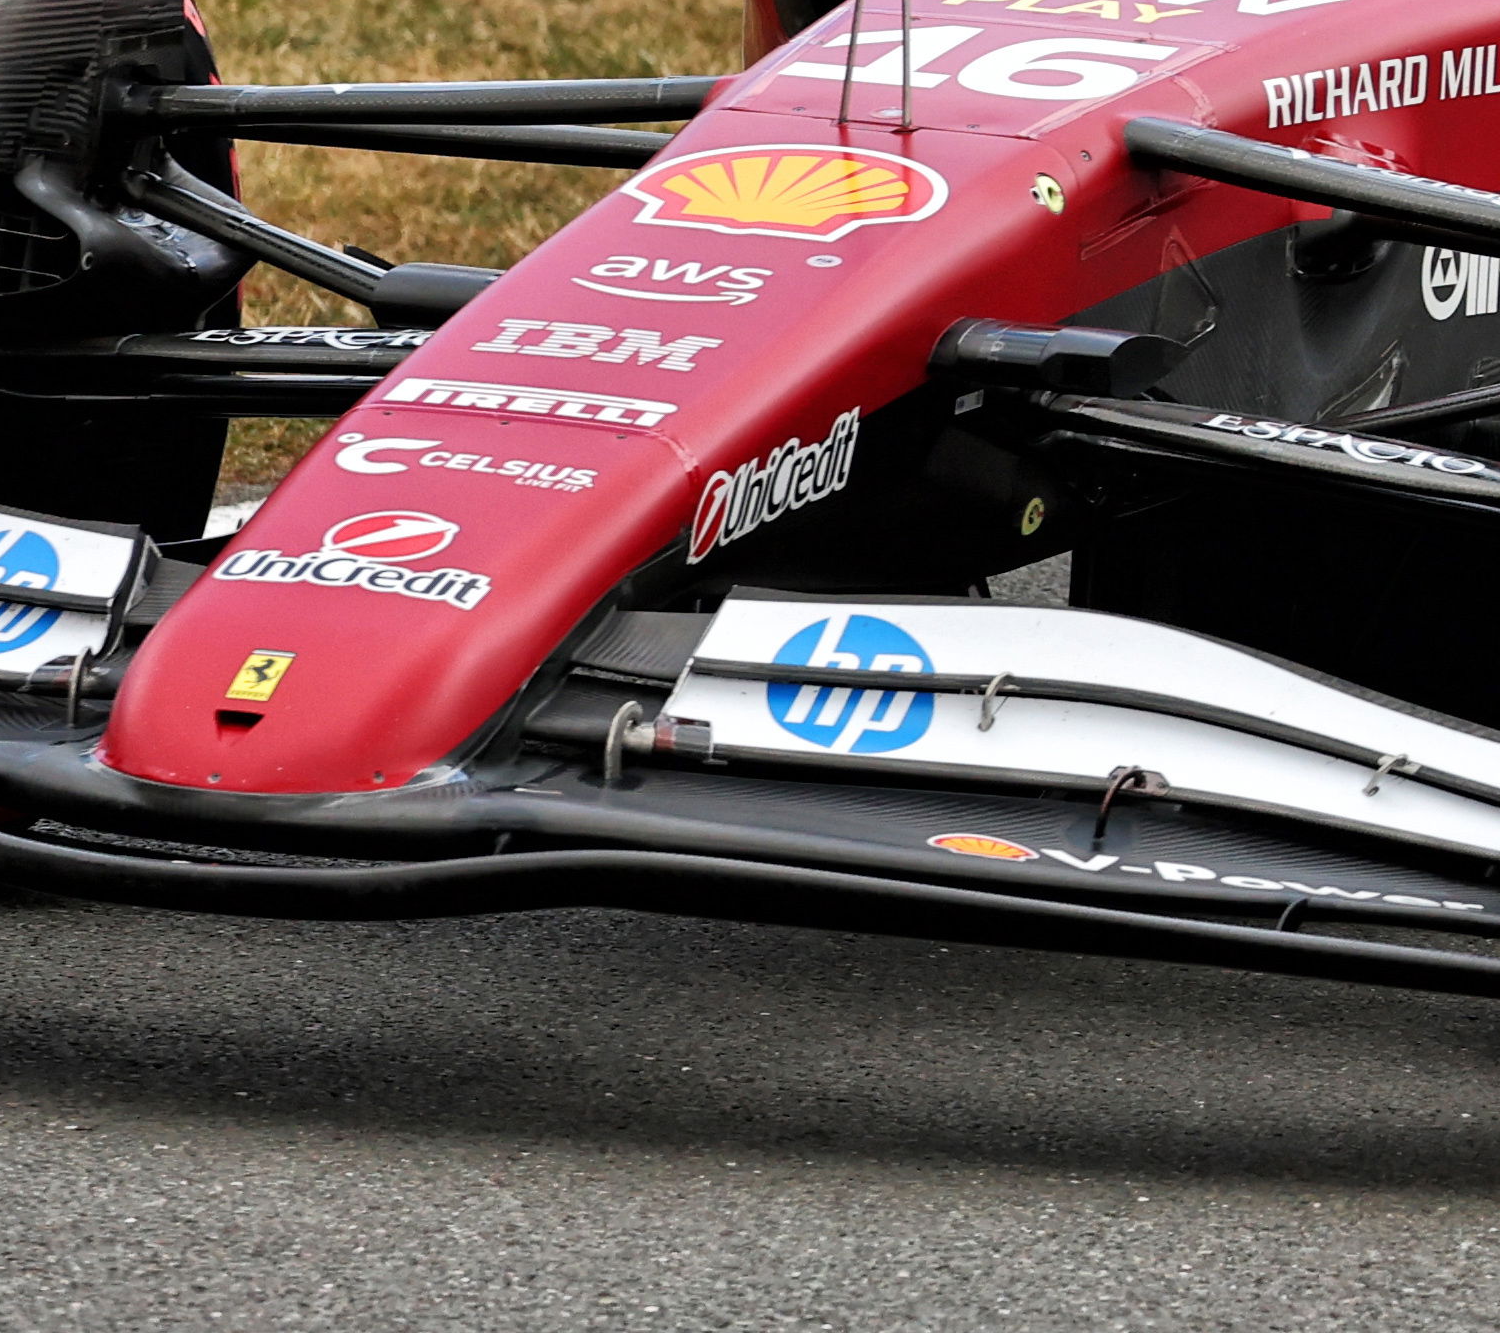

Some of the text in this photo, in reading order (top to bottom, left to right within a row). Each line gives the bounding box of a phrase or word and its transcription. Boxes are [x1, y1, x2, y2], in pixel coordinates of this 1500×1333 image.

[777, 24, 1180, 101] 16
[1262, 54, 1429, 130] RICHARD
[589, 255, 775, 290] aws
[469, 318, 725, 373] IBM
[382, 377, 679, 428] PIRELLI
[417, 450, 599, 487] CELSIUS
[1201, 412, 1488, 475] ESPACIO
[514, 477, 584, 494] LIVE FIT
[721, 417, 858, 541] UniCredit
[217, 551, 489, 607] UniCredit
[1040, 846, 1486, 911] V-Power
